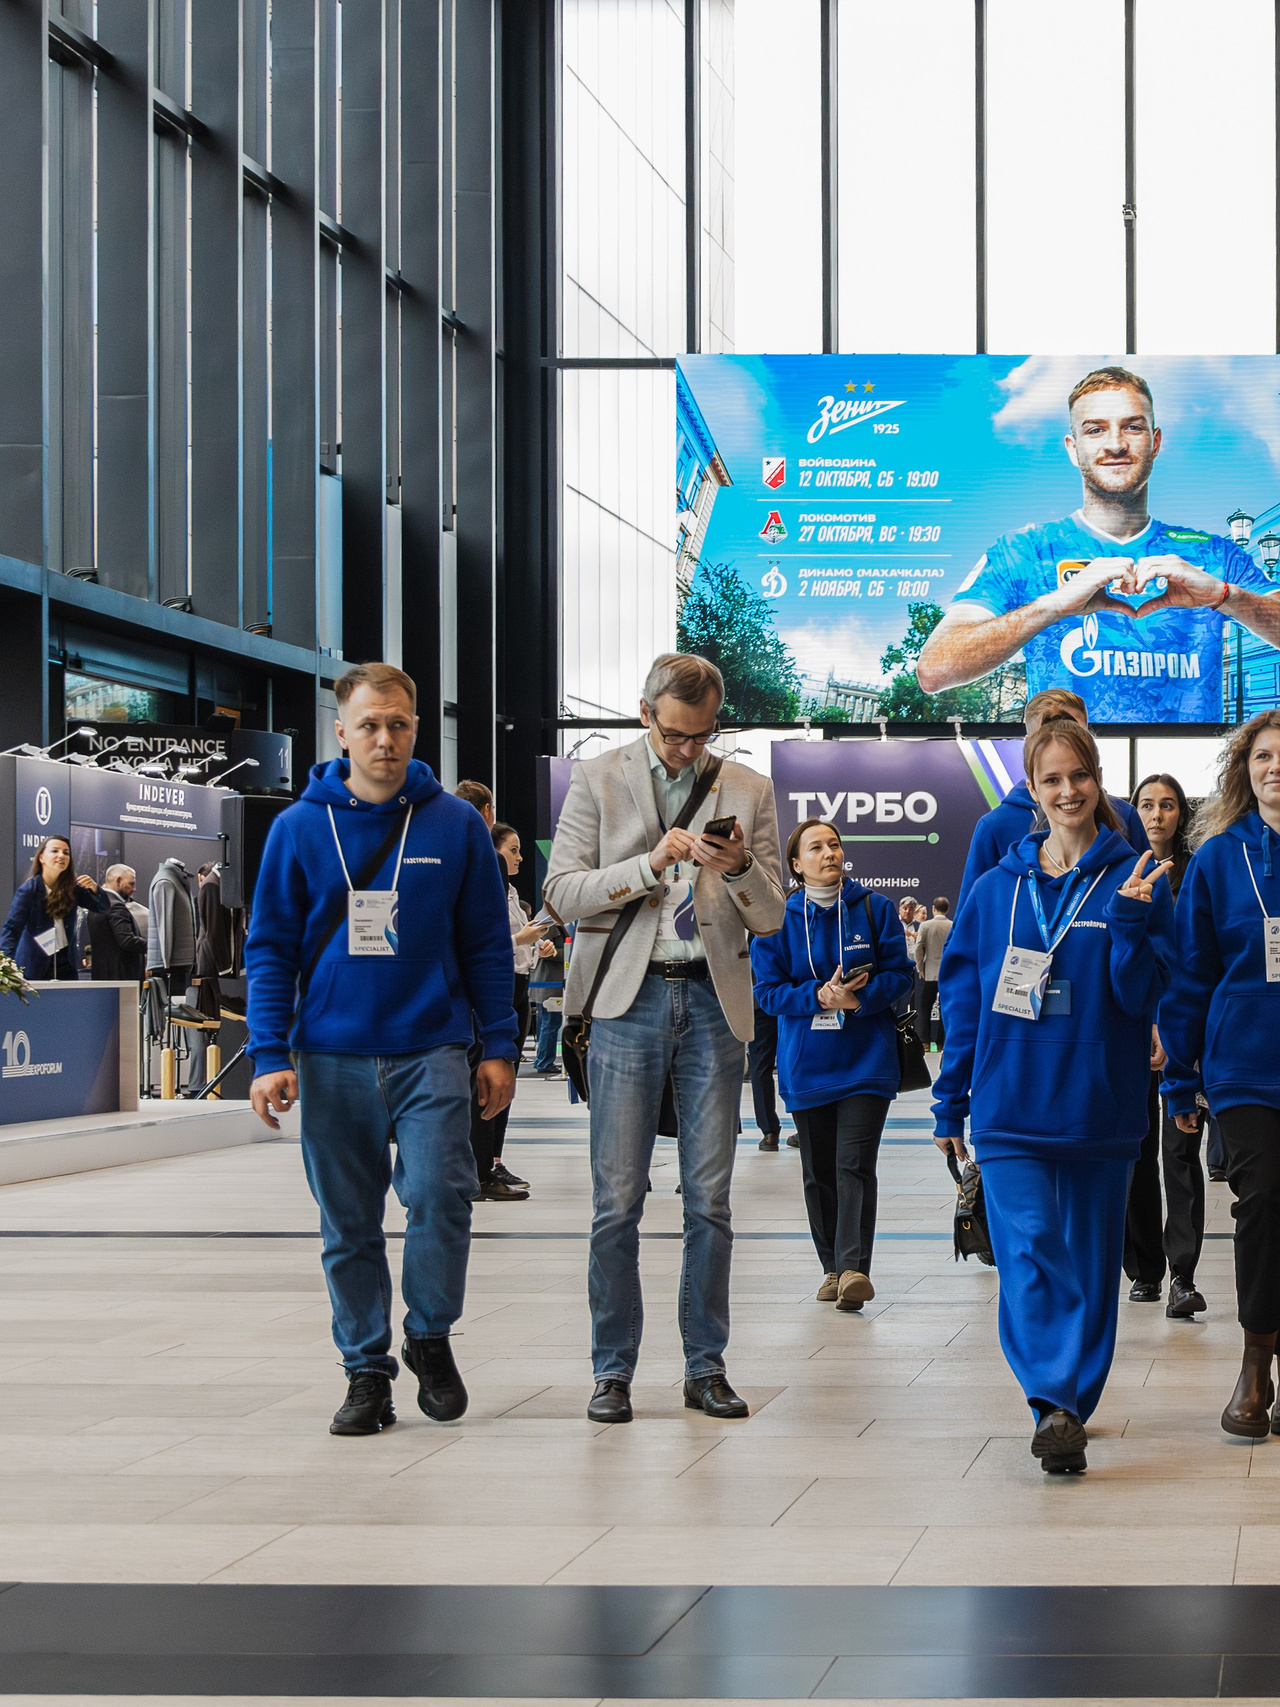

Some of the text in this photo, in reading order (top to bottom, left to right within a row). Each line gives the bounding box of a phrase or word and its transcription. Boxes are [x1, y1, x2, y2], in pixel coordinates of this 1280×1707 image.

[807, 395, 908, 444] Зенит
[873, 424, 900, 434] 1925
[798, 457, 877, 467] ВОЙВОДИНА
[798, 471, 939, 489] 12 ОКТЯБРЯ, СБ 19:00
[798, 514, 877, 522] ЛОКОМОТИВ
[798, 526, 941, 543] 27 ОКТЯБРЯ, ВС 19:30
[798, 569, 945, 578] ДИНАМО (МАХАЧКАЛА)
[798, 581, 930, 598] 2 НОЯБРЯ, СБ 18:00
[1103, 650, 1200, 679] ГАЗПРОМ
[89, 736, 226, 755] NO ENTRANCE
[278, 748, 290, 769] 11
[139, 784, 185, 806] INDEVER
[788, 791, 938, 823] ТУРБО
[1071, 920, 1107, 929] АЗСТРОЙПРОМ
[997, 1003, 1032, 1016] SPECIALIST
